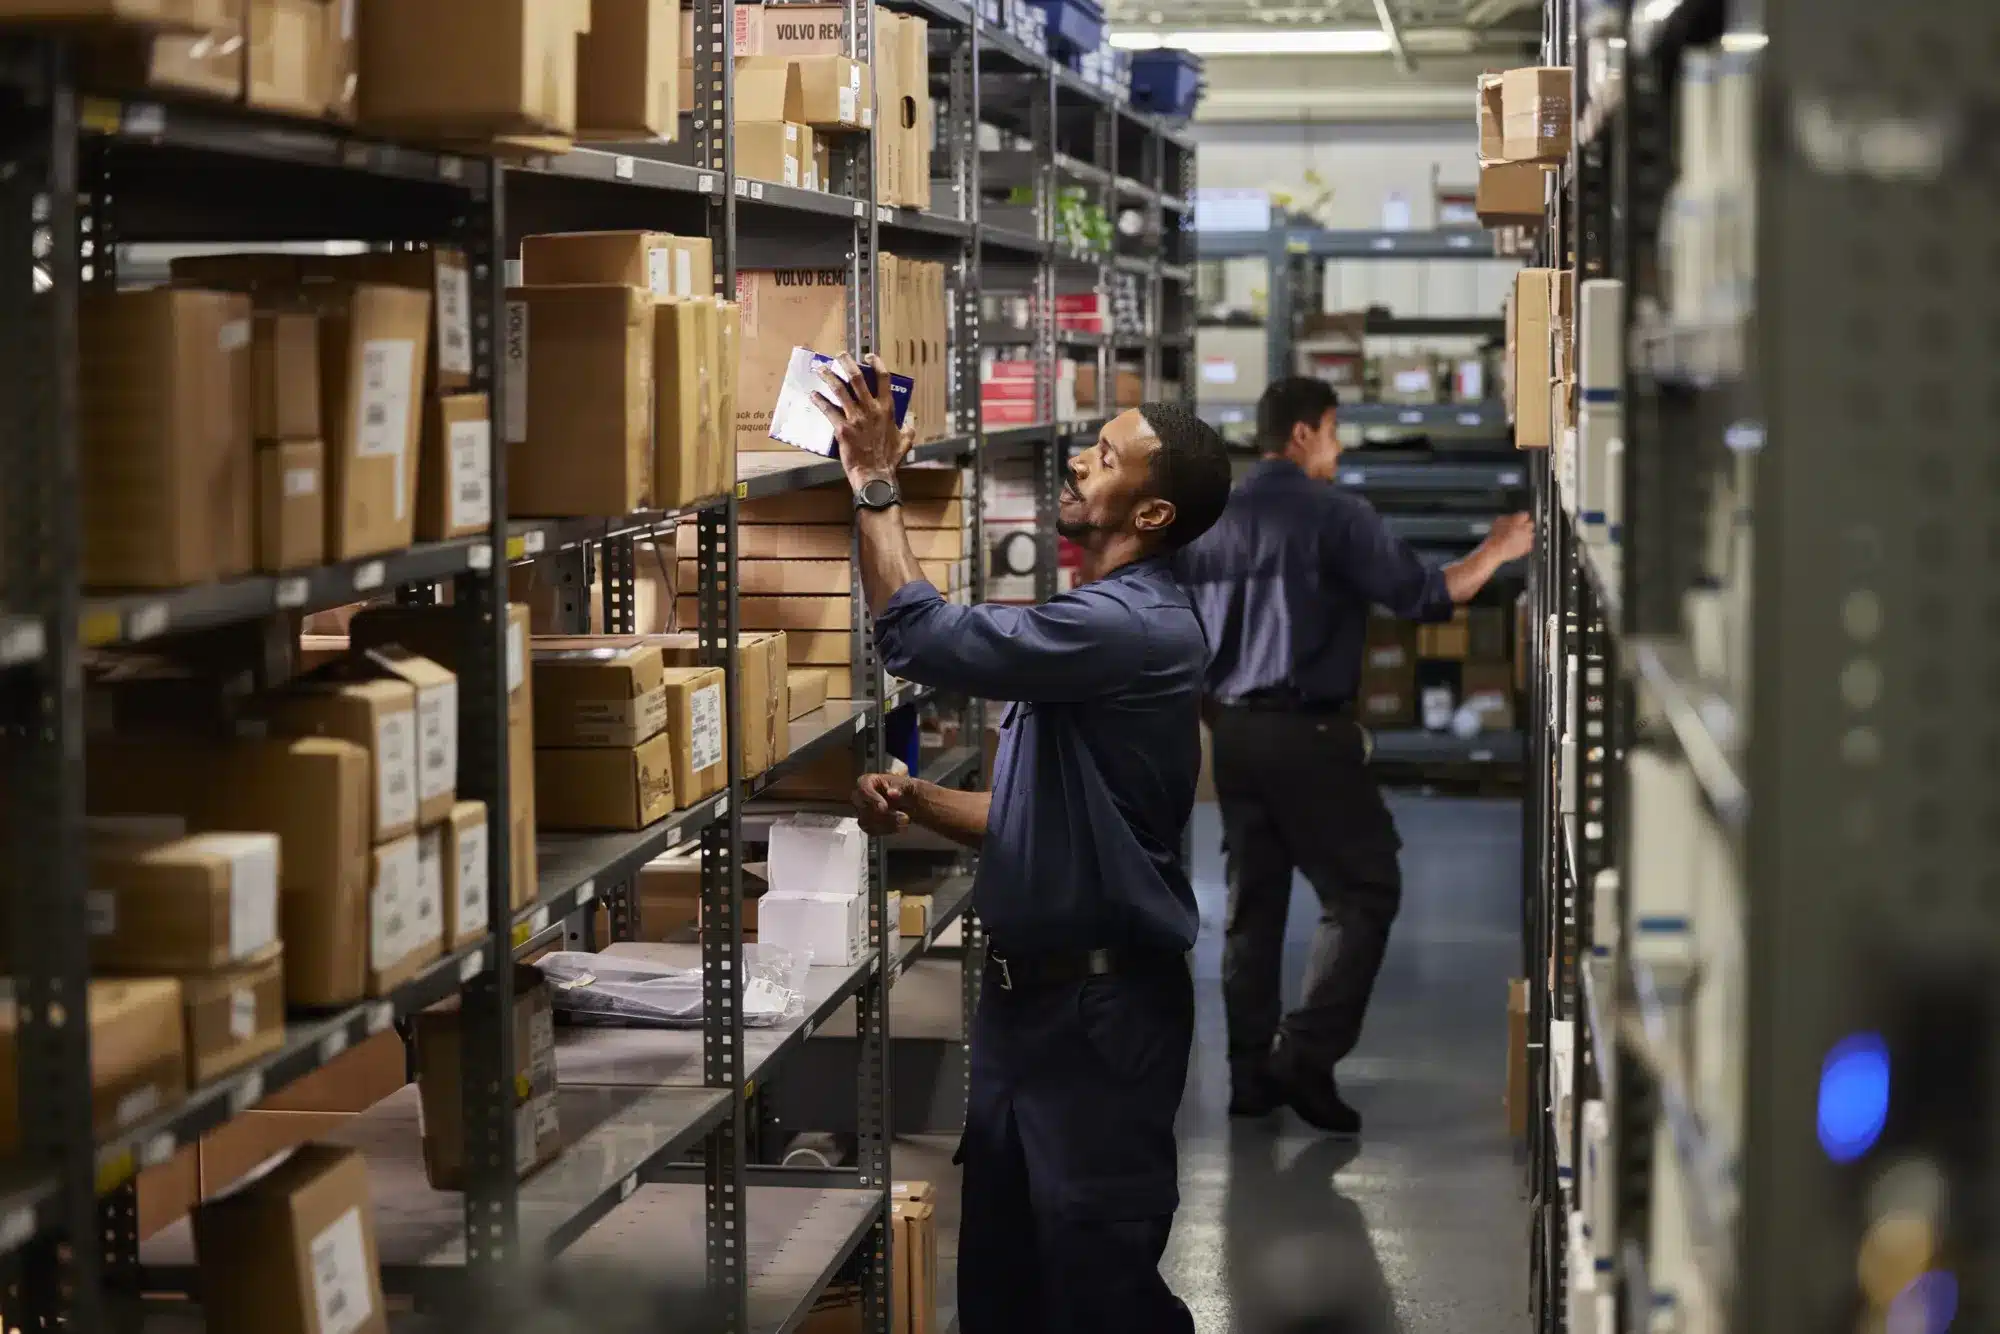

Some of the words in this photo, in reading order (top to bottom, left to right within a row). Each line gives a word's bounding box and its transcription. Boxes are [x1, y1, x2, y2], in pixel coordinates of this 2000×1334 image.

[776, 24, 815, 40] VOLVO
[774, 268, 813, 286] VOLVO
[509, 305, 524, 359] VOLVO
[890, 383, 908, 394] LVO
